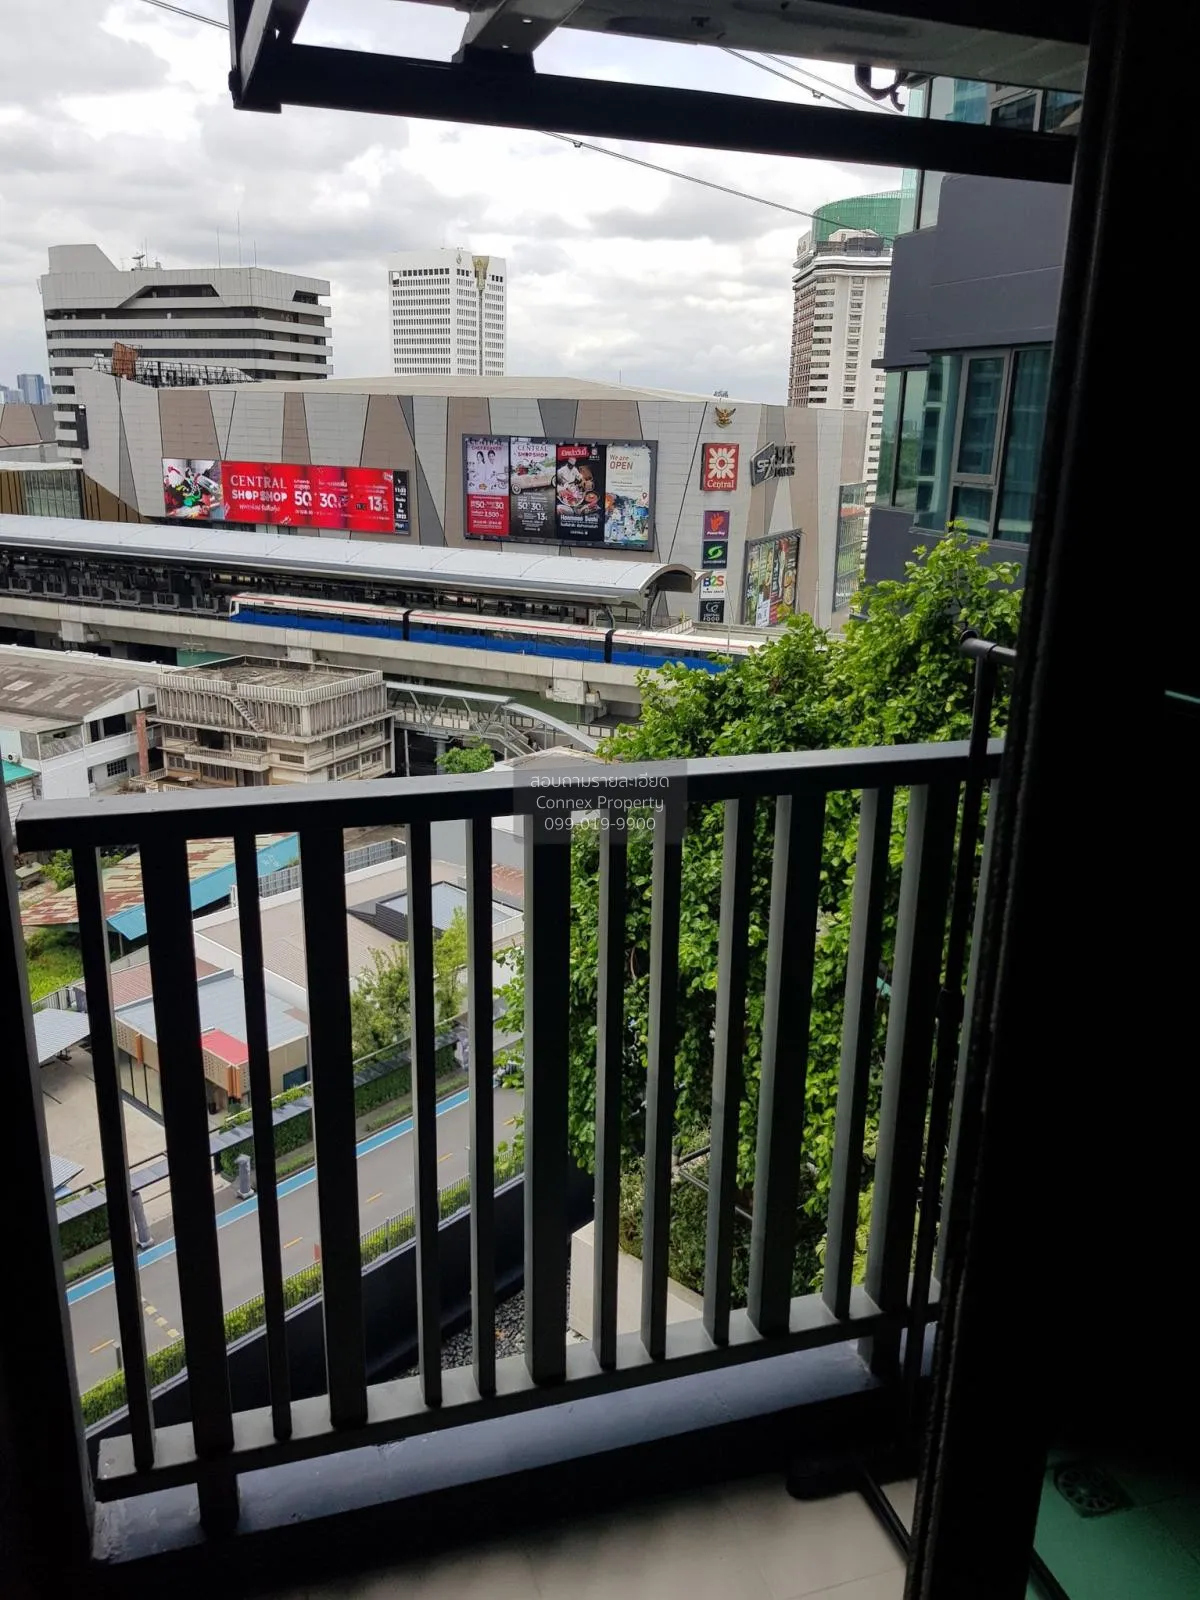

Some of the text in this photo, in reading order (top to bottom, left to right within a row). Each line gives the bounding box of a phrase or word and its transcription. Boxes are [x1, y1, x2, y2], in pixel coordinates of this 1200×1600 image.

[609, 461, 633, 470] OPEN
[230, 474, 288, 489] CENTRAL
[707, 480, 734, 489] Central
[703, 575, 724, 587] B2S
